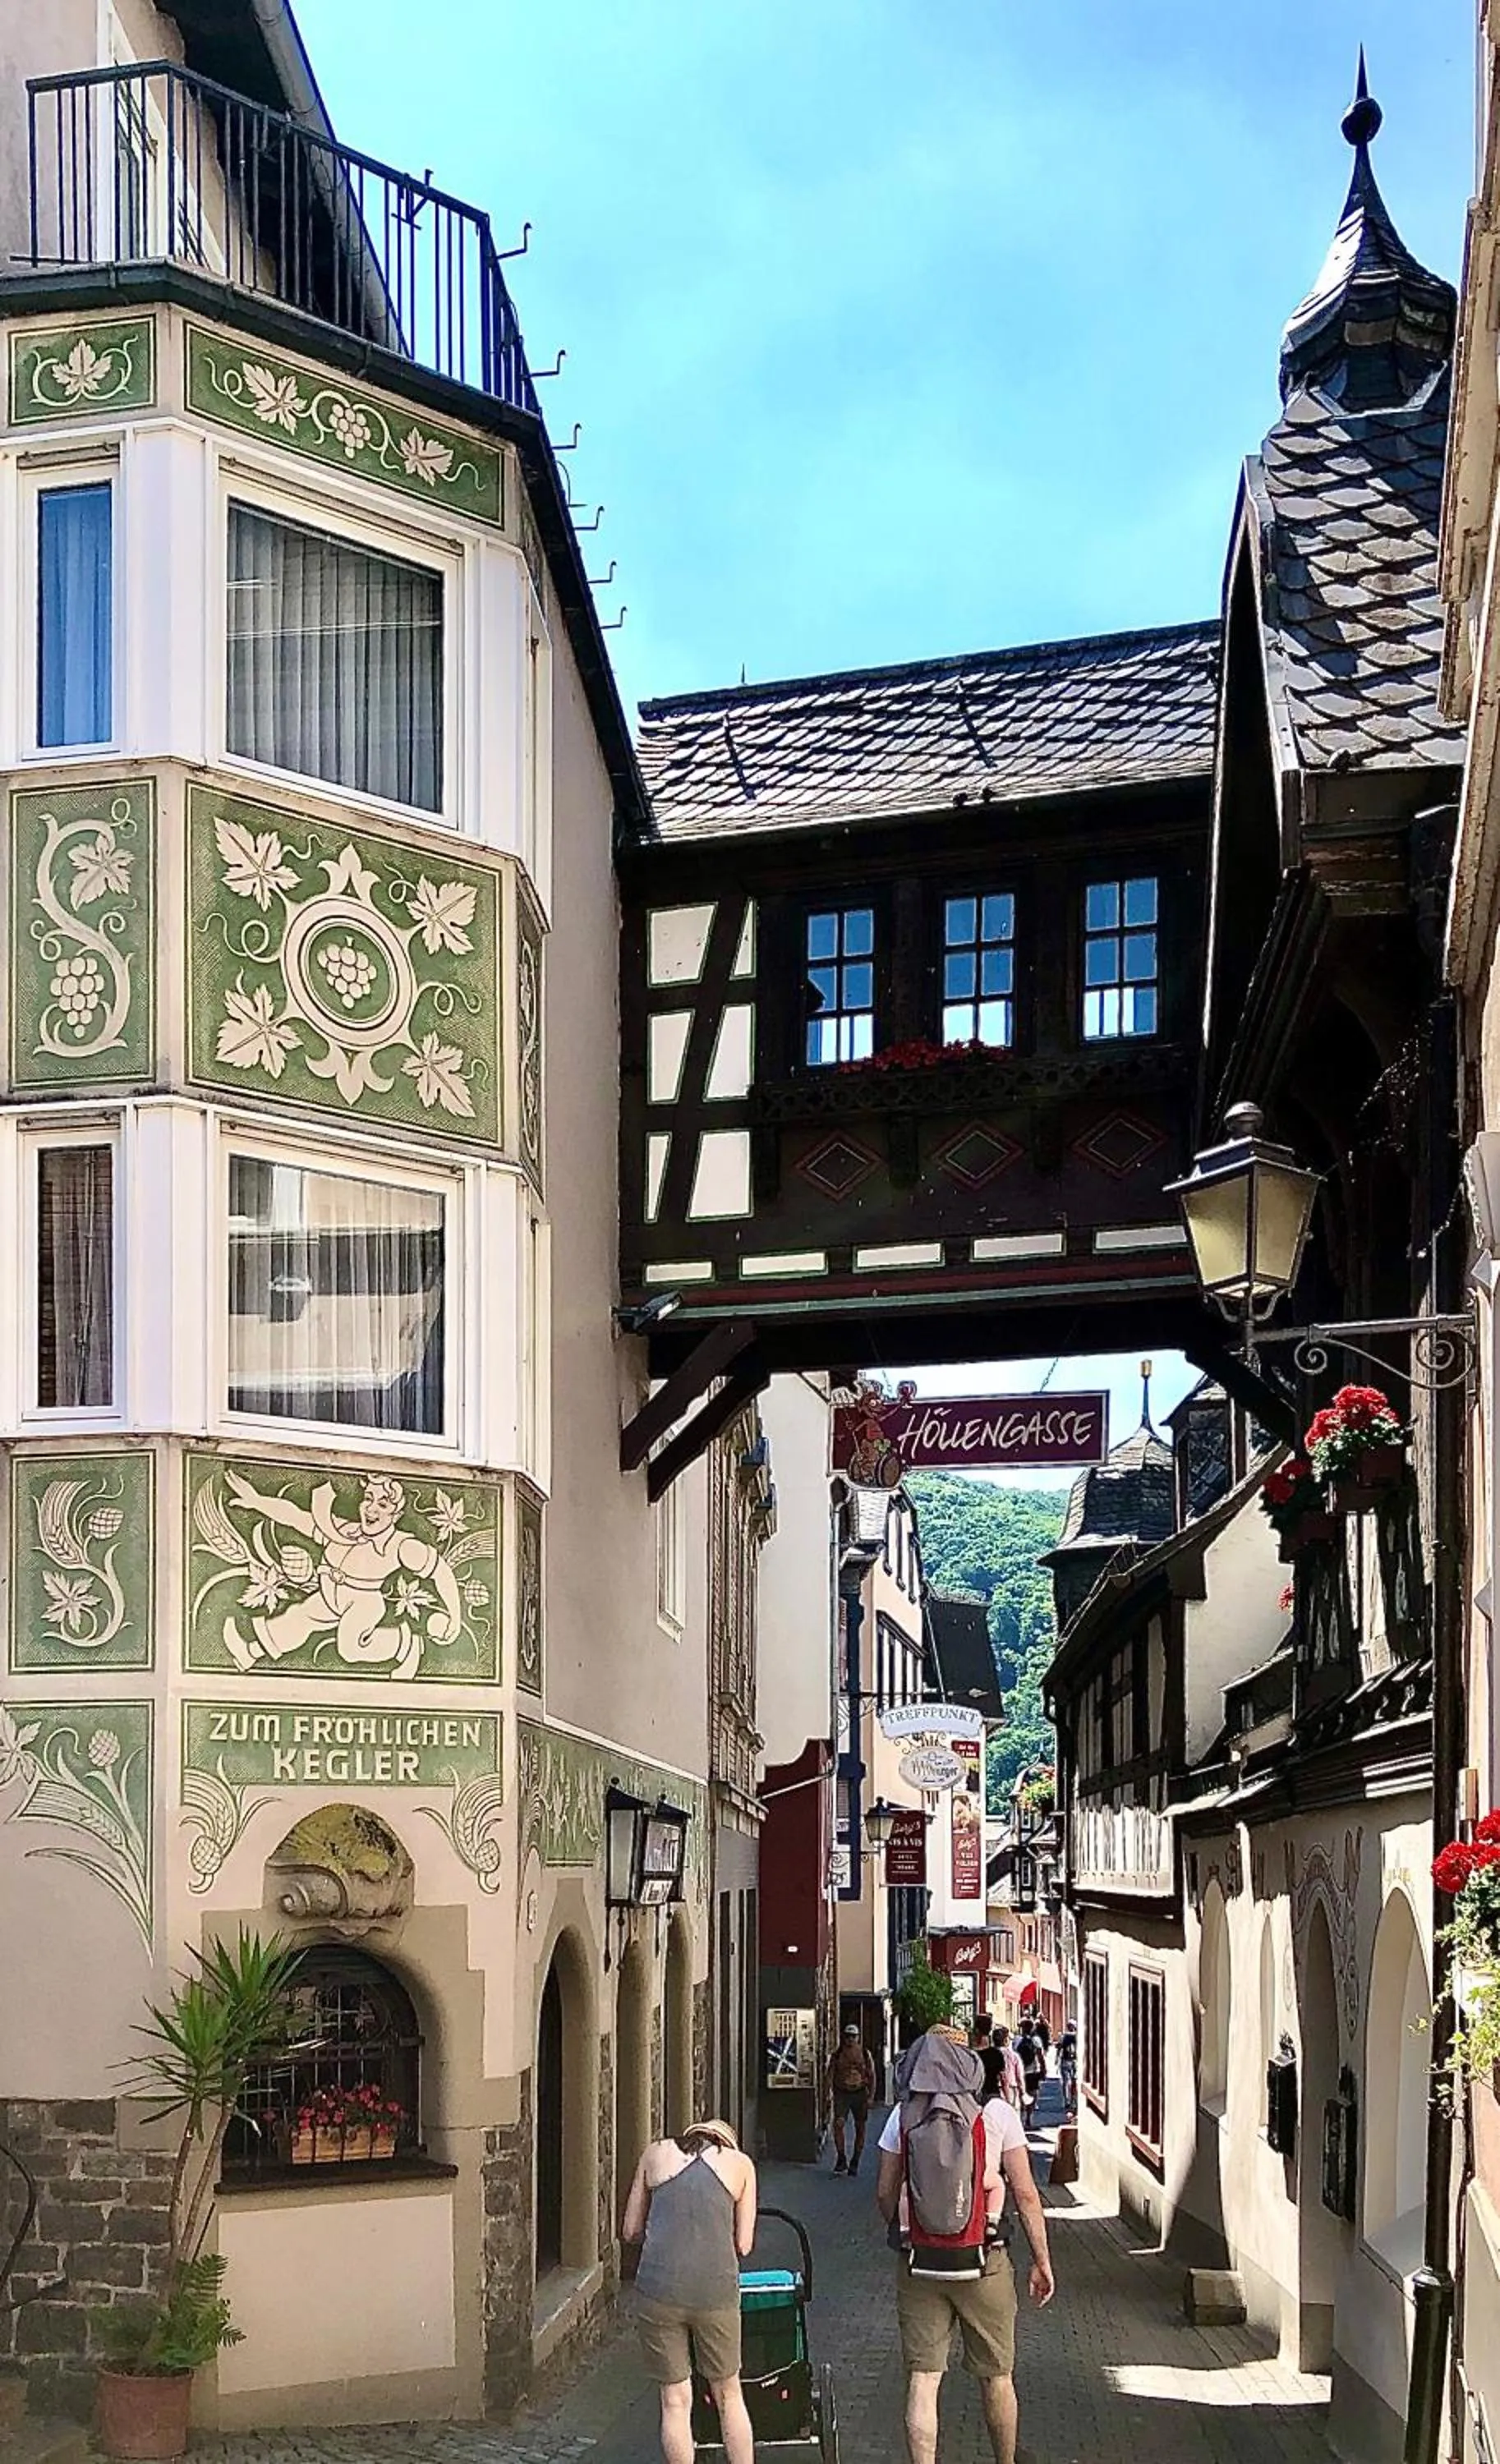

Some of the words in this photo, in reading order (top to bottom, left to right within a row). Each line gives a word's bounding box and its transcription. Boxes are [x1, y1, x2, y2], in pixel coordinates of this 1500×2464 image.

[896, 1407, 1096, 1460] HÖLLENGASSE
[209, 1712, 280, 1742] ZUM
[292, 1715, 482, 1748] FRÖHLICHEN
[885, 1708, 978, 1723] TREFFPUNKT
[272, 1747, 421, 1781] KEGLER
